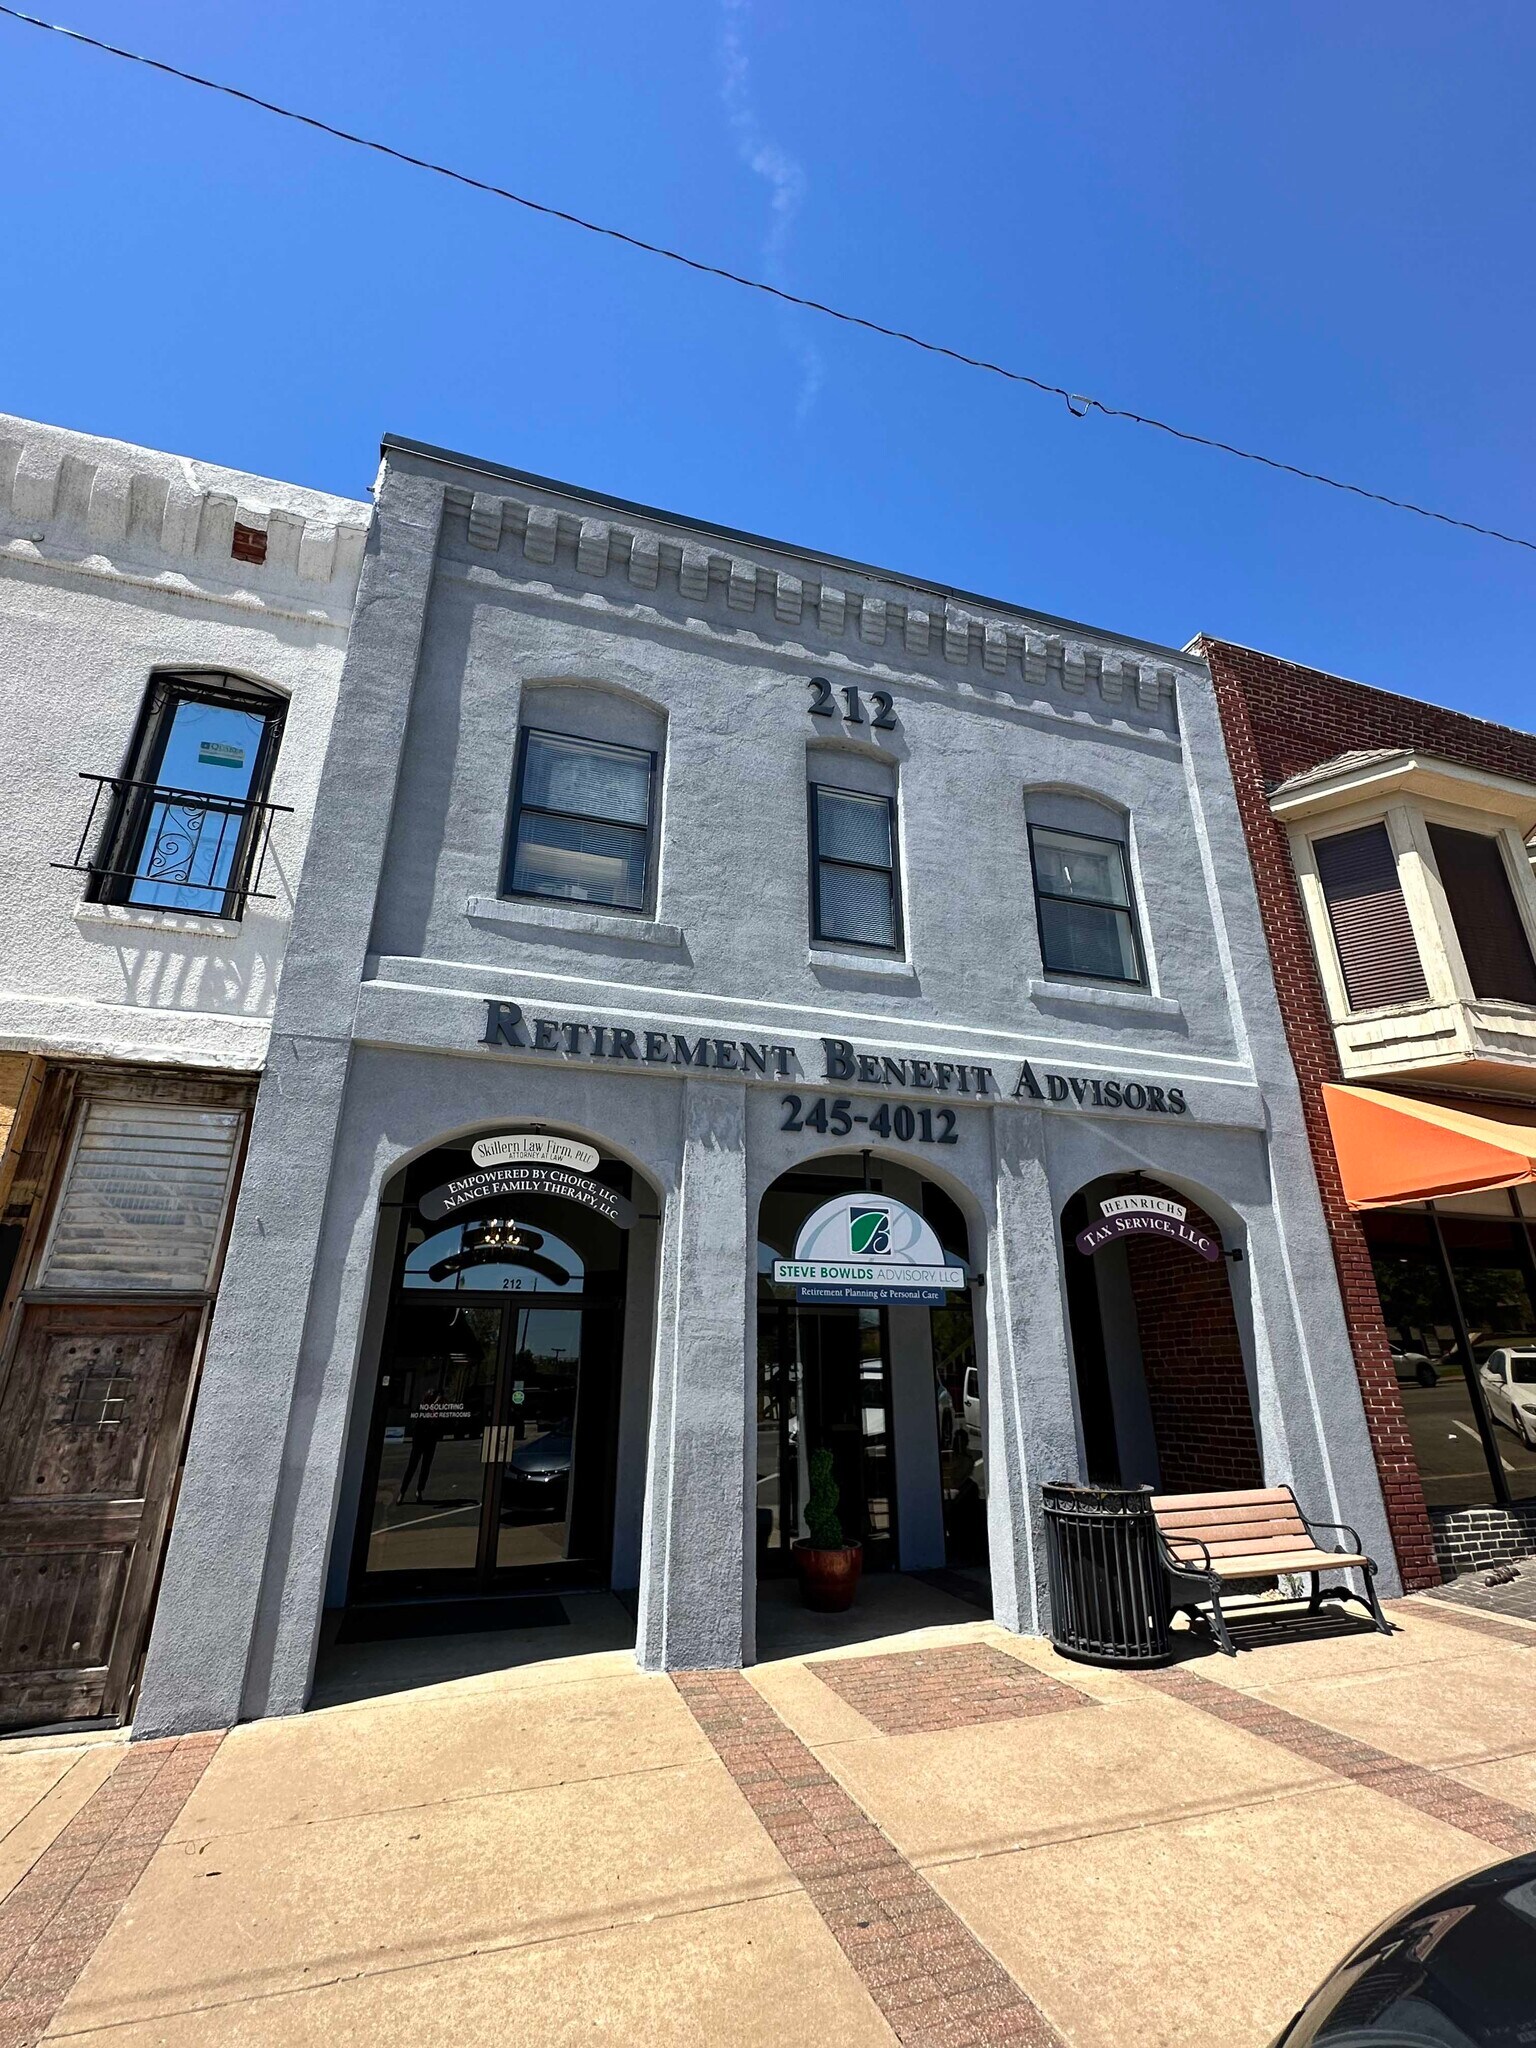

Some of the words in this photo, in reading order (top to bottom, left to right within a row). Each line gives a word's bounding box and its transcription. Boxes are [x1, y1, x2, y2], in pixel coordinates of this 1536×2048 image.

[808, 677, 897, 730] 212
[478, 999, 795, 1075] RETIREMENT
[821, 1037, 993, 1094] BENEFIT
[1012, 1060, 1187, 1114] ADVISORS
[781, 1095, 959, 1144] 245-4012
[477, 1140, 520, 1158] Skillern
[523, 1138, 543, 1152] Law
[575, 1150, 594, 1164] PLLC
[552, 1154, 564, 1162] LAW
[448, 1169, 529, 1194] EMPOWERED
[532, 1170, 548, 1179] BY
[550, 1170, 597, 1196] CHOICE,
[598, 1188, 618, 1204] LLC
[443, 1186, 491, 1210] NANCE
[493, 1181, 541, 1193] FAMILY
[543, 1182, 599, 1208] THERAPY,
[599, 1203, 619, 1219] LLC
[1104, 1199, 1184, 1217] HEINRICHS
[1083, 1224, 1113, 1247] TAX
[1115, 1217, 1176, 1235] SERVICE,
[1178, 1225, 1210, 1251] LLC
[502, 1278, 522, 1290] 212
[779, 1265, 817, 1278] STEVE
[820, 1267, 874, 1280] BOWLDS
[877, 1269, 937, 1282] ADVISORY,
[939, 1271, 960, 1283] LLC
[801, 1287, 843, 1297] Retirement
[845, 1288, 879, 1300] Planning
[879, 1290, 888, 1299] &
[889, 1290, 920, 1300] Personal
[922, 1291, 939, 1300] Care
[430, 1403, 463, 1411] SOLICITING
